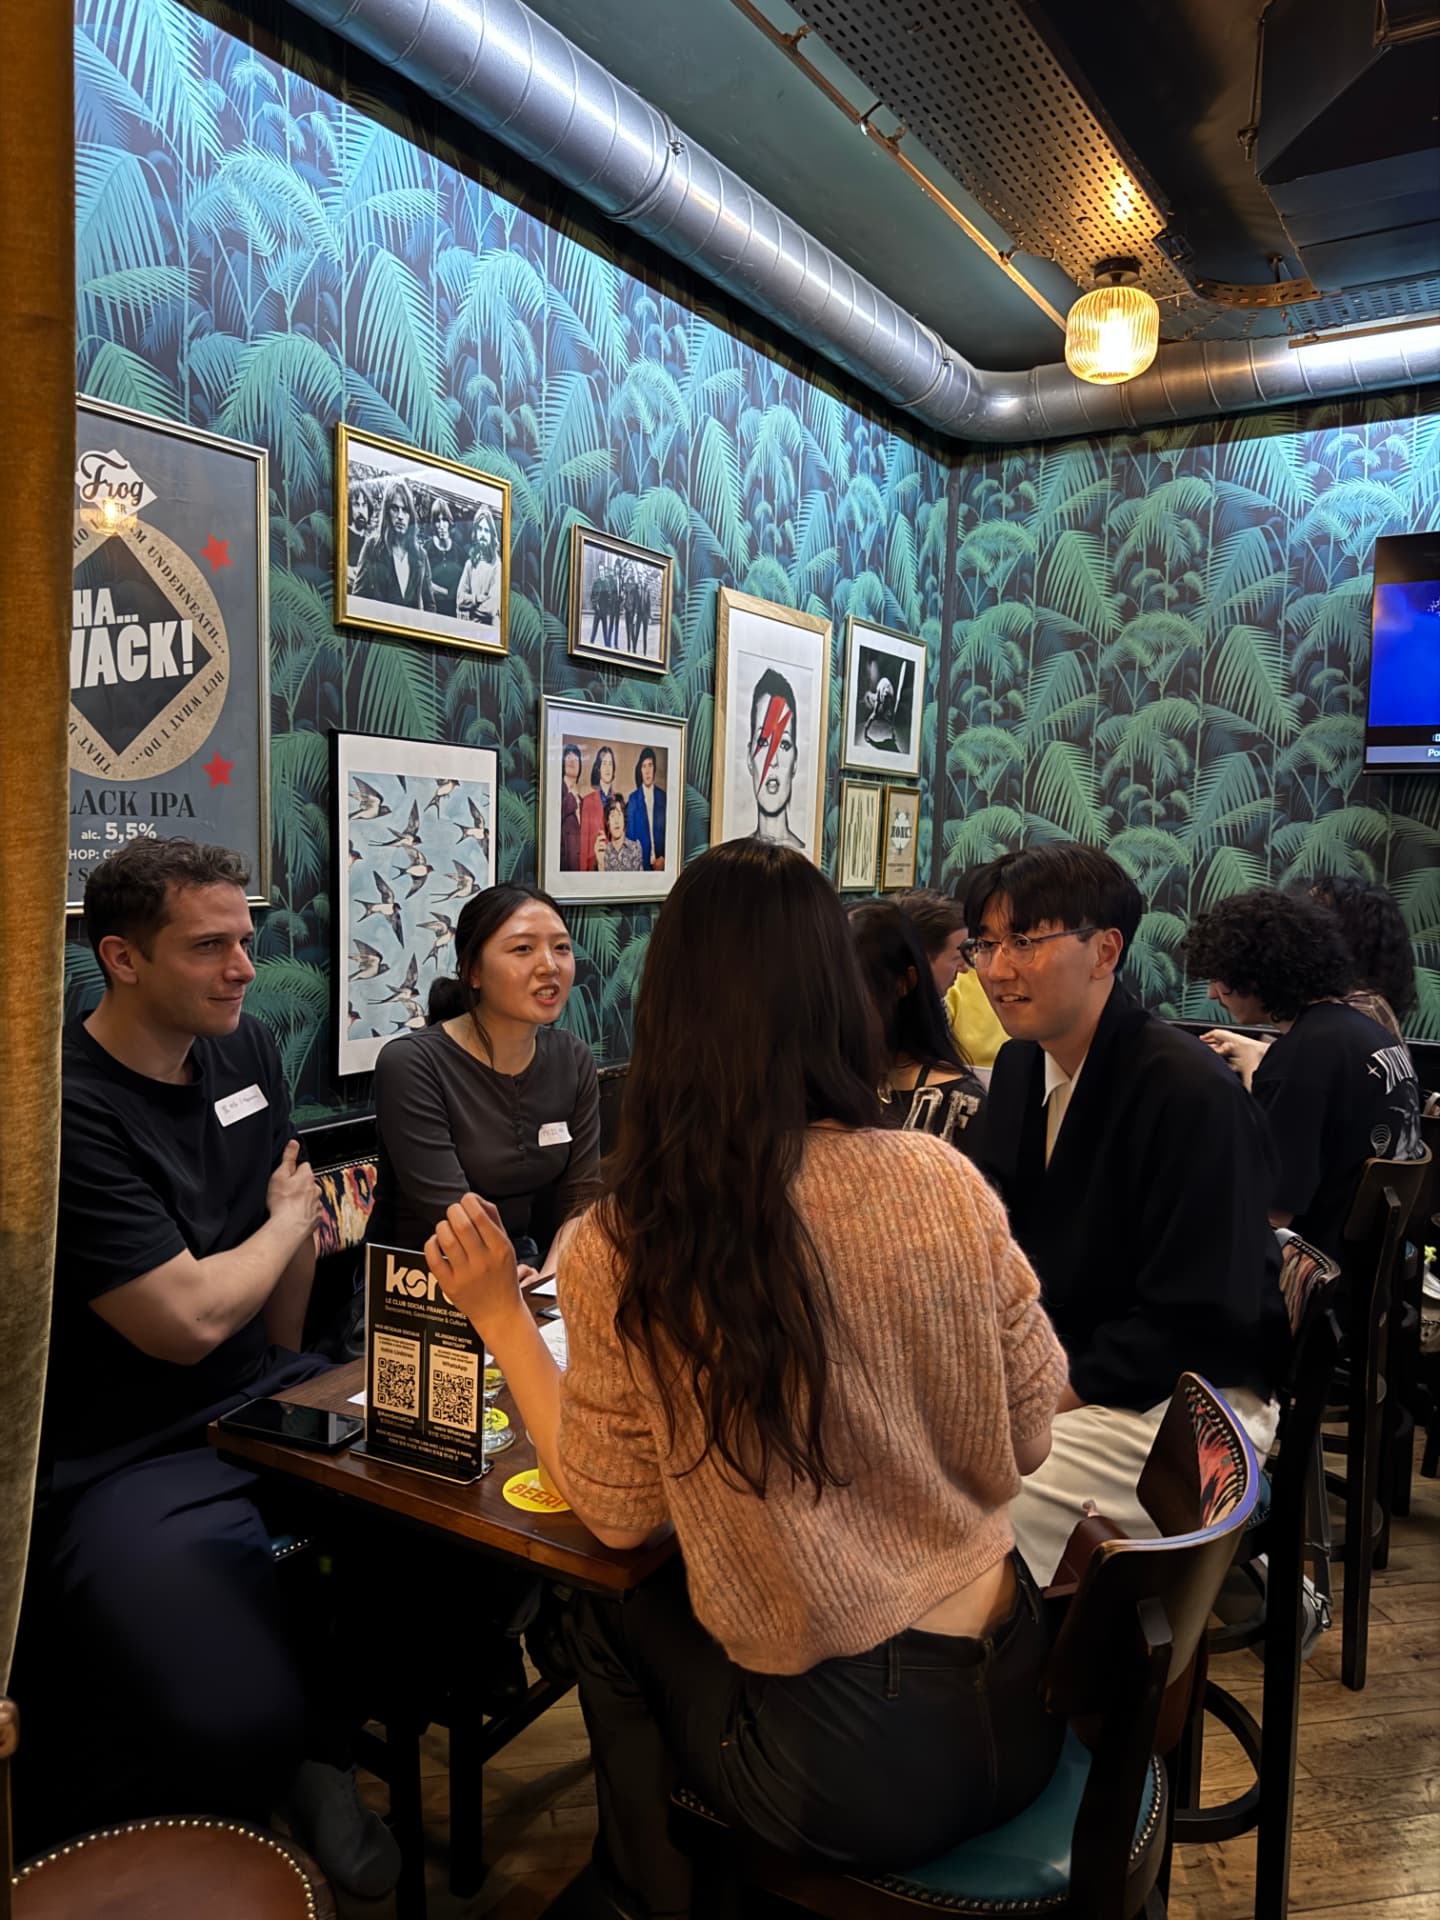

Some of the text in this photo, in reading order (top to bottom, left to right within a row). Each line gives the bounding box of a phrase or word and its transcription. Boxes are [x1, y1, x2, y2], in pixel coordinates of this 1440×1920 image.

[80, 453, 144, 506] Frog
[146, 545, 225, 654] UNDERNEATH...
[131, 670, 225, 765] BUT WHAT I DO...
[77, 736, 111, 775] THAT
[149, 791, 197, 818] IPA
[81, 821, 157, 844] alc. 5,5%
[385, 1253, 455, 1306] kor
